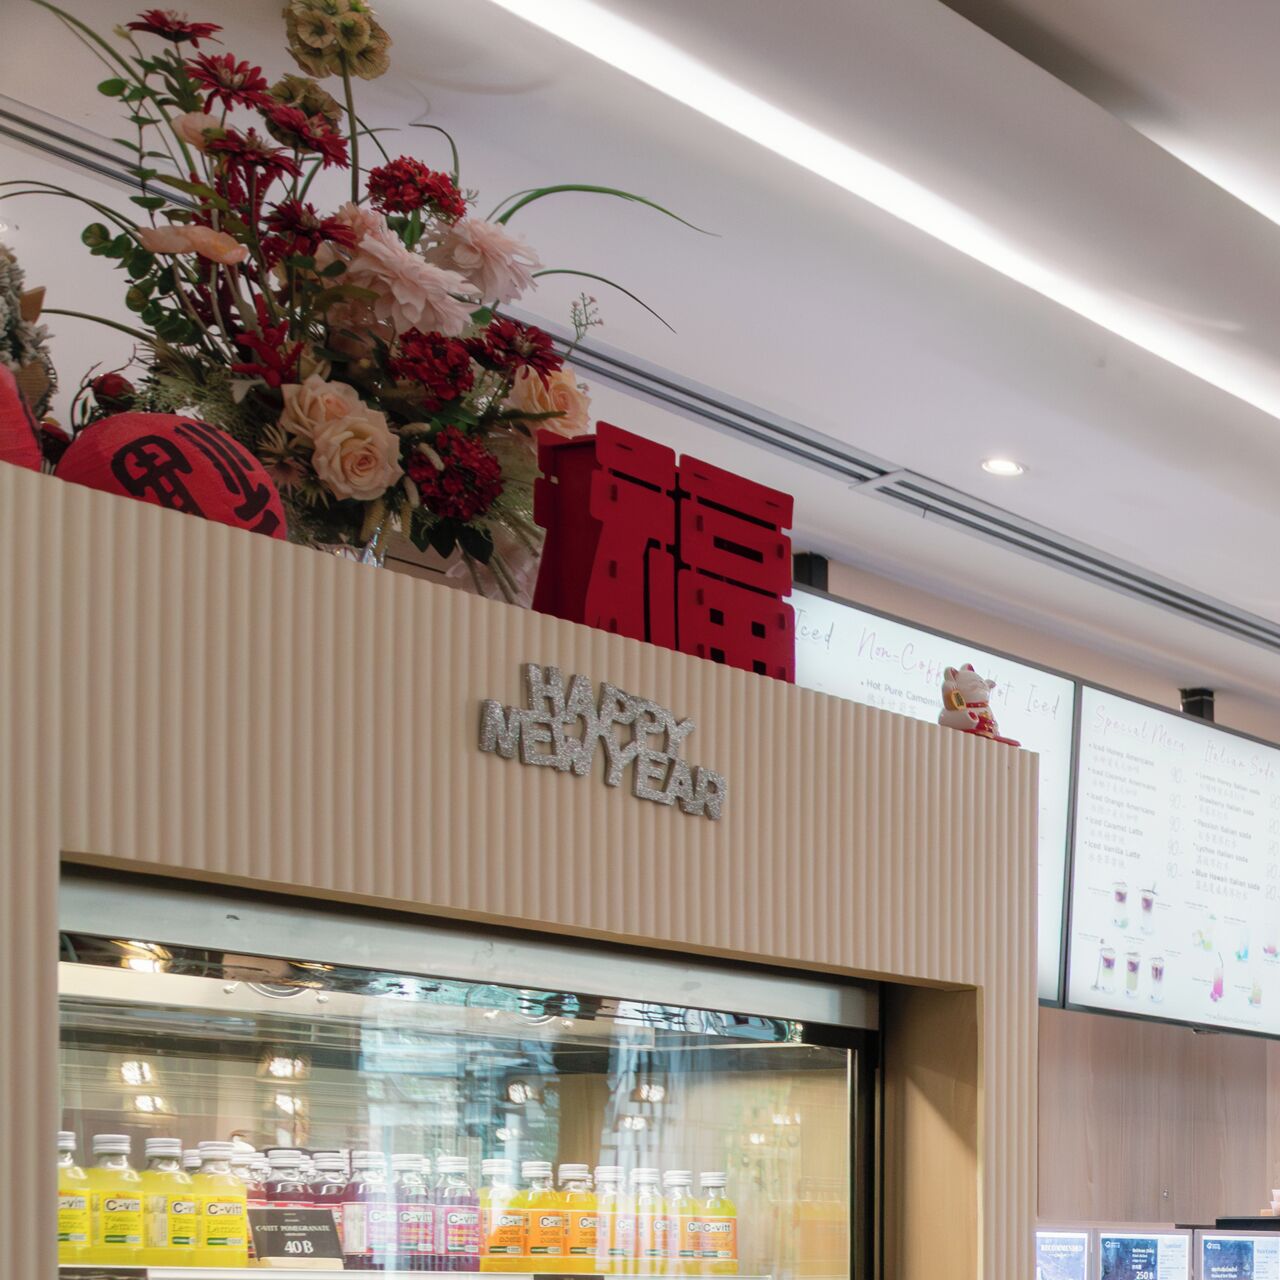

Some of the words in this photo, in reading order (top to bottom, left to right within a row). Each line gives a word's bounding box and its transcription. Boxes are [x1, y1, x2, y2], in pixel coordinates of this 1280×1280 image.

[866, 679, 881, 690] Hot
[883, 684, 903, 698] Pure
[905, 690, 944, 709] Camomil
[1024, 684, 1060, 720] Iced
[522, 663, 696, 757] HAPPY
[1094, 704, 1148, 740] Special
[478, 699, 596, 776] NEW
[602, 737, 728, 822] YEAR
[105, 1199, 140, 1212] C-vitt
[207, 1202, 242, 1215] C-vitt
[400, 1211, 432, 1223] C-vitt
[449, 1212, 478, 1224] C-vitt
[703, 1222, 731, 1232] C-vitt
[1136, 1271, 1149, 1280] 250
